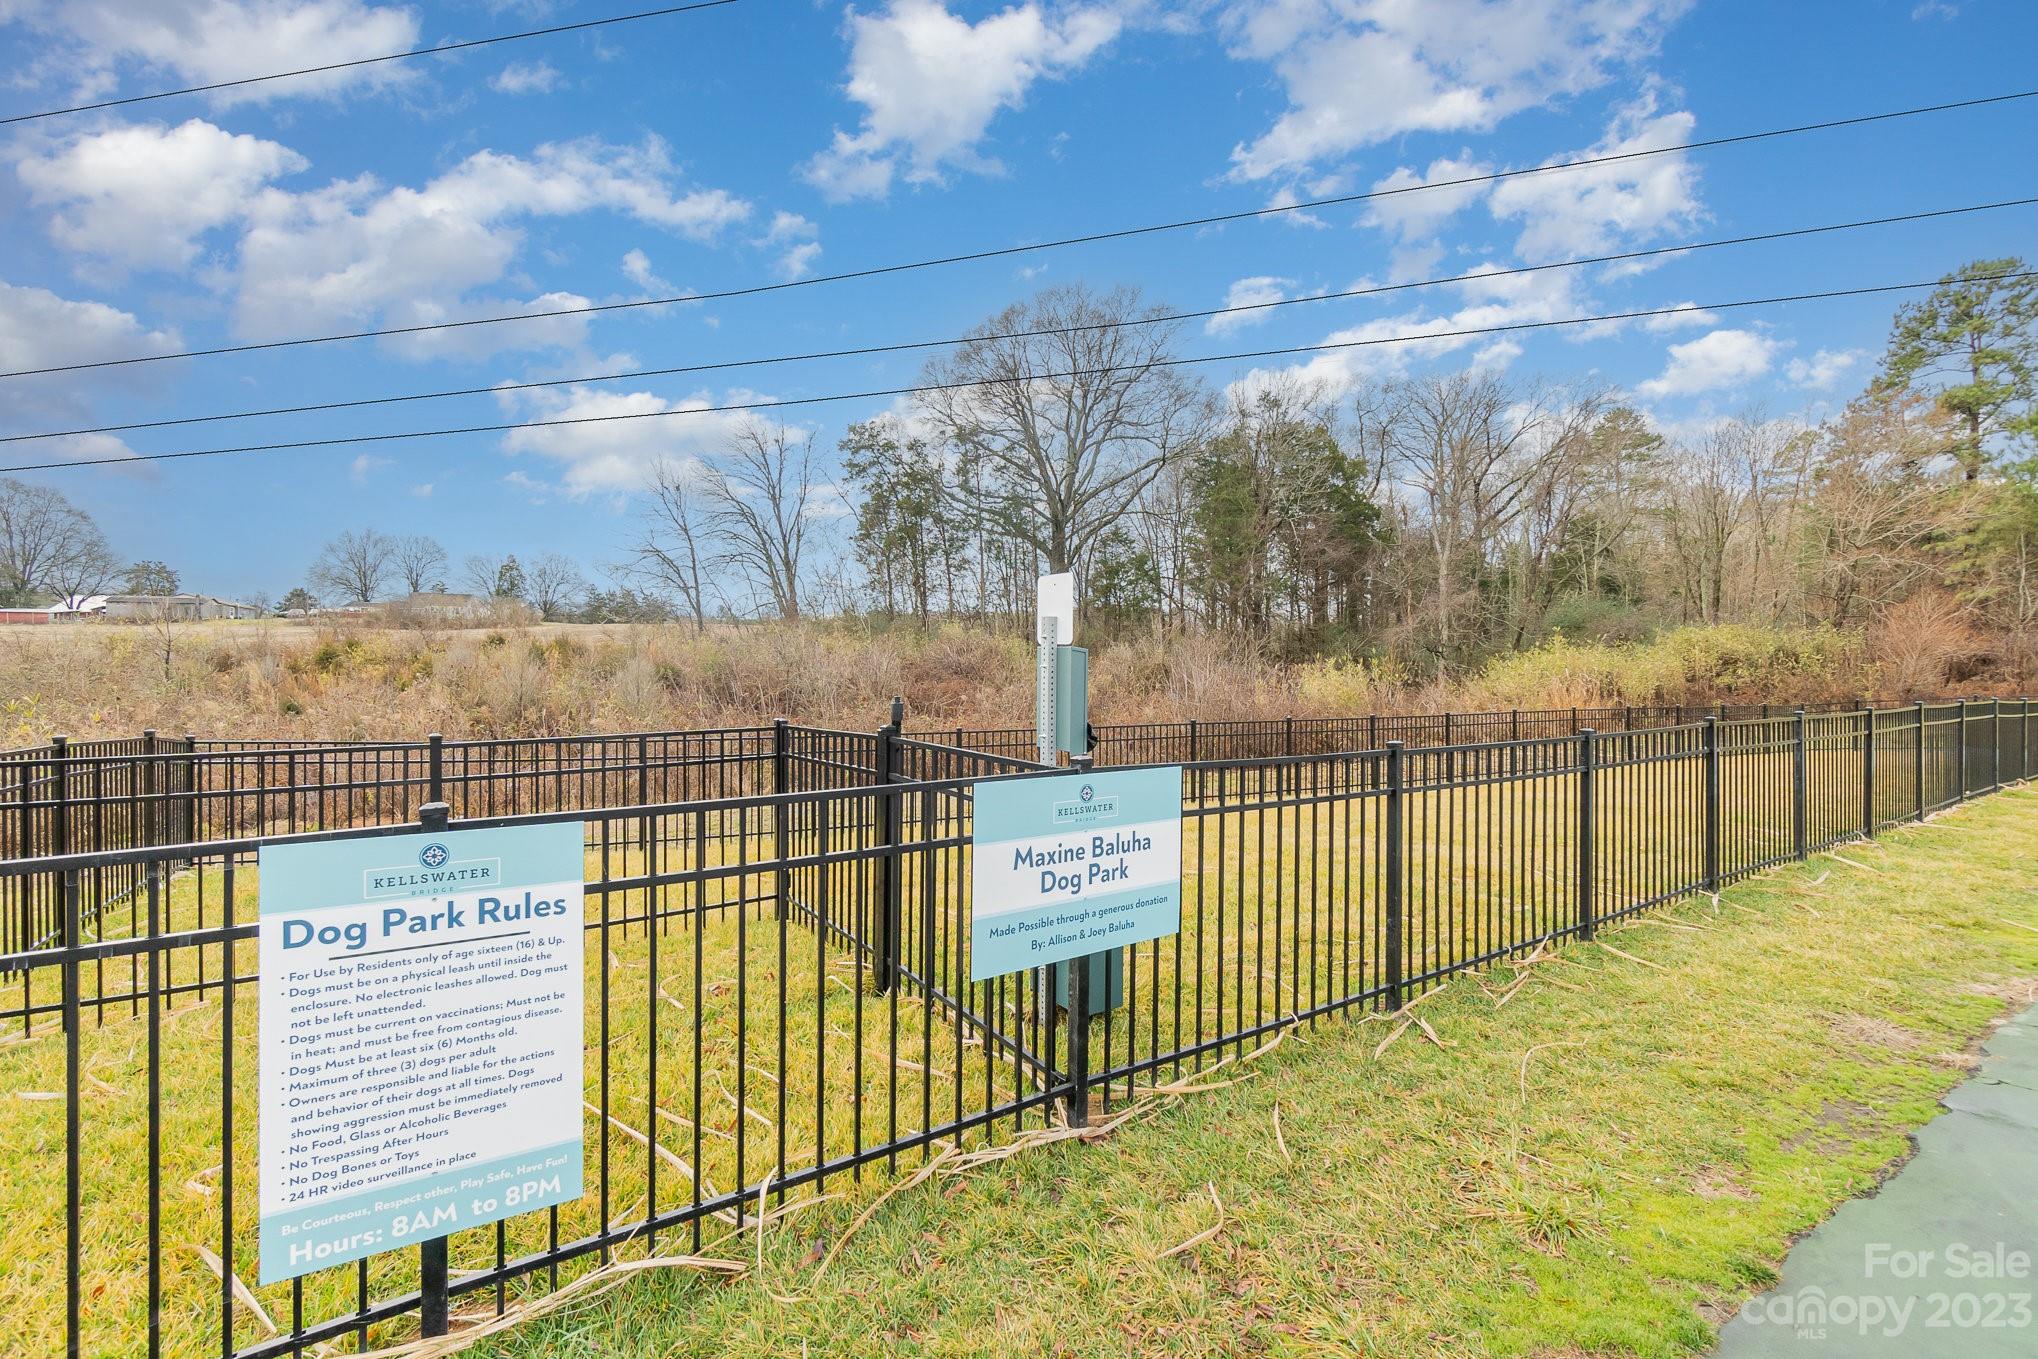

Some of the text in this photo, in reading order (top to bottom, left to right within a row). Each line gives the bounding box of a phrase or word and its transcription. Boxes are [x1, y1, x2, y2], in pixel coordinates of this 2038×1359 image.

[1057, 803, 1114, 817] KELLSWATER
[1013, 830, 1151, 871] Maxine Baluha
[373, 867, 490, 889] KELLSWATER
[1040, 857, 1129, 895] Dog Park
[282, 891, 567, 951] Dog Park Rules
[989, 895, 1168, 939] Made Possible through a generous donation
[1031, 919, 1135, 952] By: Allison & Joey Baluha
[289, 936, 565, 983] For Use by Residents only of age sixteen (16) & Up.
[289, 951, 553, 998] Dogs must be on a physical leash until inside the
[290, 998, 352, 1013] enclosure.
[355, 992, 373, 1003] No
[376, 984, 432, 1000] electronic
[435, 978, 473, 991] leashes
[520, 968, 542, 978] Dog
[544, 963, 568, 974] must
[289, 1034, 322, 1045] Dogs
[324, 1027, 354, 1039] must
[357, 1023, 372, 1034] be
[374, 1016, 417, 1031] current
[418, 1015, 433, 1023] on
[506, 997, 532, 1008] Must
[534, 993, 551, 1003] not
[553, 991, 566, 1000] be
[291, 998, 426, 1029] not be left unattended.
[291, 1051, 302, 1061] in
[339, 1039, 361, 1052] and
[364, 1035, 393, 1048] must
[395, 1032, 410, 1042] be
[412, 1028, 435, 1039] free
[437, 1024, 463, 1035] from
[465, 1014, 522, 1030] contagious
[524, 1007, 563, 1019] disease.
[289, 1026, 518, 1077] Dogs Must be at least six (6) Months old.
[289, 1044, 497, 1093] Maximum of three (3) dogs per adult
[289, 1049, 555, 1108] Owners are responsible and liable for the actions
[290, 1068, 535, 1124] and behavior of their dogs at all times. Dogs
[289, 1144, 308, 1156] No
[349, 1129, 381, 1142] Glass
[383, 1126, 396, 1134] or
[398, 1112, 450, 1131] Alcoholic
[453, 1101, 507, 1119] Beverages
[290, 1072, 563, 1139] showing aggression must be immediately removed
[289, 1129, 449, 1171] No Trespassing After Hours
[289, 1150, 420, 1187] No Dog Bones or Toys
[281, 1224, 299, 1237] Be
[374, 1193, 422, 1212] Respect
[460, 1177, 485, 1190] Play
[516, 1163, 543, 1175] Have
[545, 1154, 568, 1168] Fun!
[289, 1151, 477, 1203] 24 HR video surveillance in place
[289, 1174, 561, 1266] Hours: 8AM to 8PM
